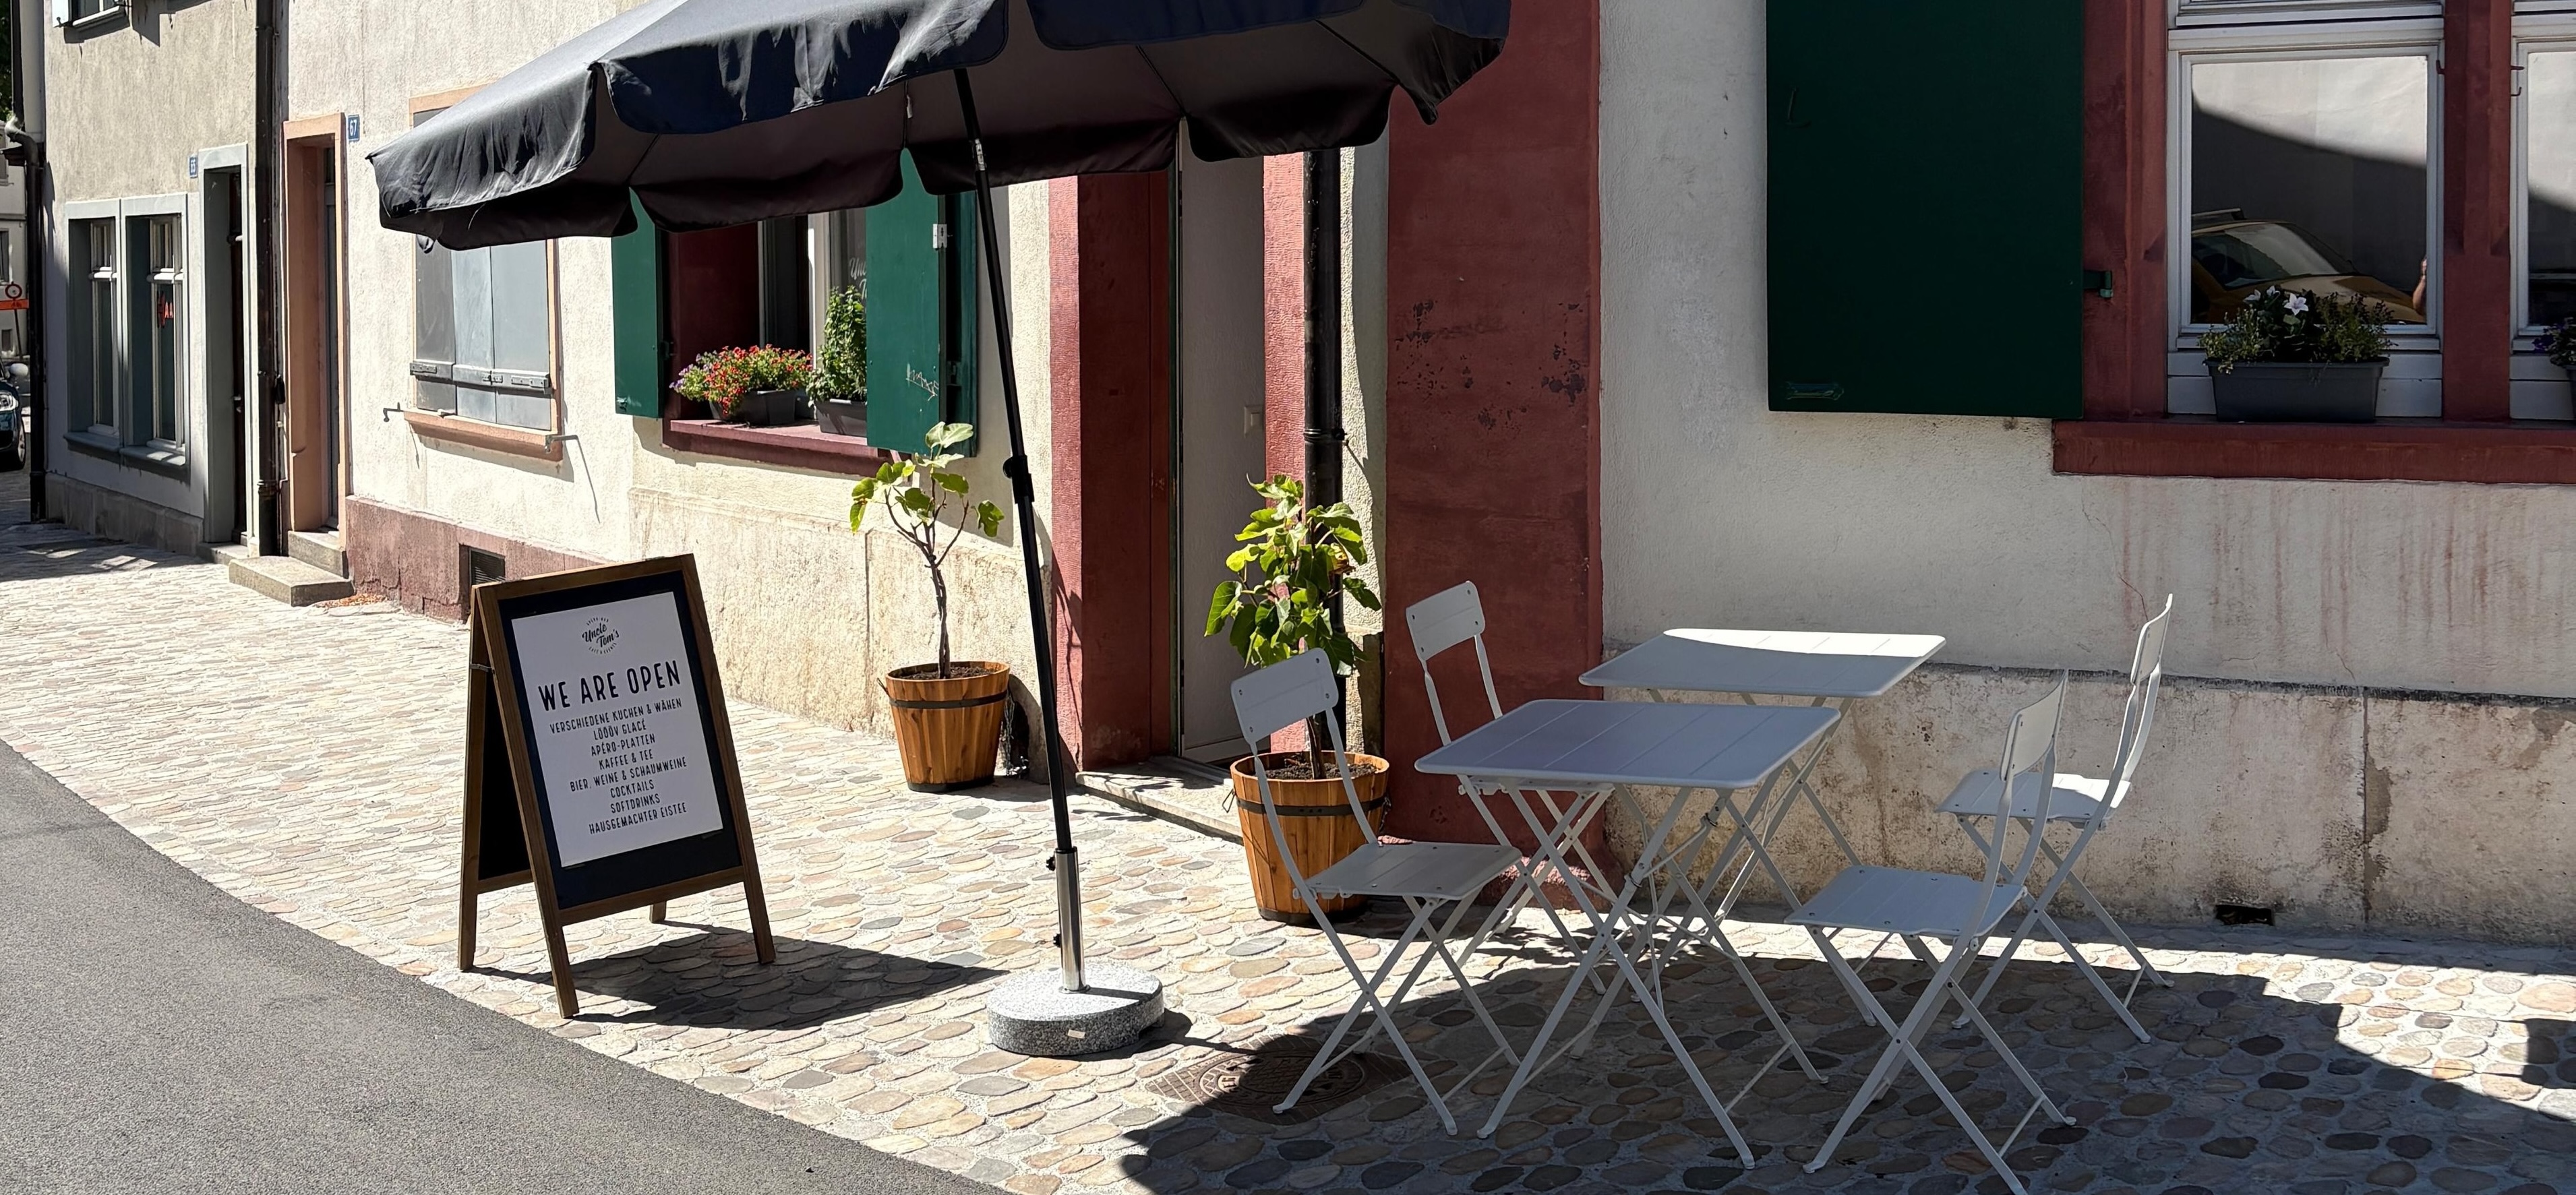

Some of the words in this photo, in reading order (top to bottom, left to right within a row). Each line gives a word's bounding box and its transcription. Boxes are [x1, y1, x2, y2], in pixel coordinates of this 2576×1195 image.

[349, 119, 357, 136] 67
[582, 622, 607, 642] Uncle
[596, 629, 620, 648] Tom's
[538, 681, 570, 712] WE
[580, 672, 619, 704] ARE
[626, 660, 680, 694] OPEN
[549, 712, 610, 734] VERSCHIEDENE
[612, 706, 644, 721] KUCHEN
[647, 704, 652, 714] &
[622, 718, 647, 735] GLACÉ
[591, 733, 655, 756] APÉRO-PLATTEN
[599, 754, 629, 770] KAFFEE
[632, 752, 637, 763] &
[640, 749, 653, 762] TEE
[593, 772, 619, 787] WEINE
[622, 770, 627, 780] &
[630, 756, 688, 778] SCHAUMWEINE
[610, 779, 655, 798] COCKTAILS
[610, 793, 661, 814] SOFTDRINKS
[589, 809, 658, 834] HAUSGEMACHTER
[660, 802, 687, 818] EISTEE
